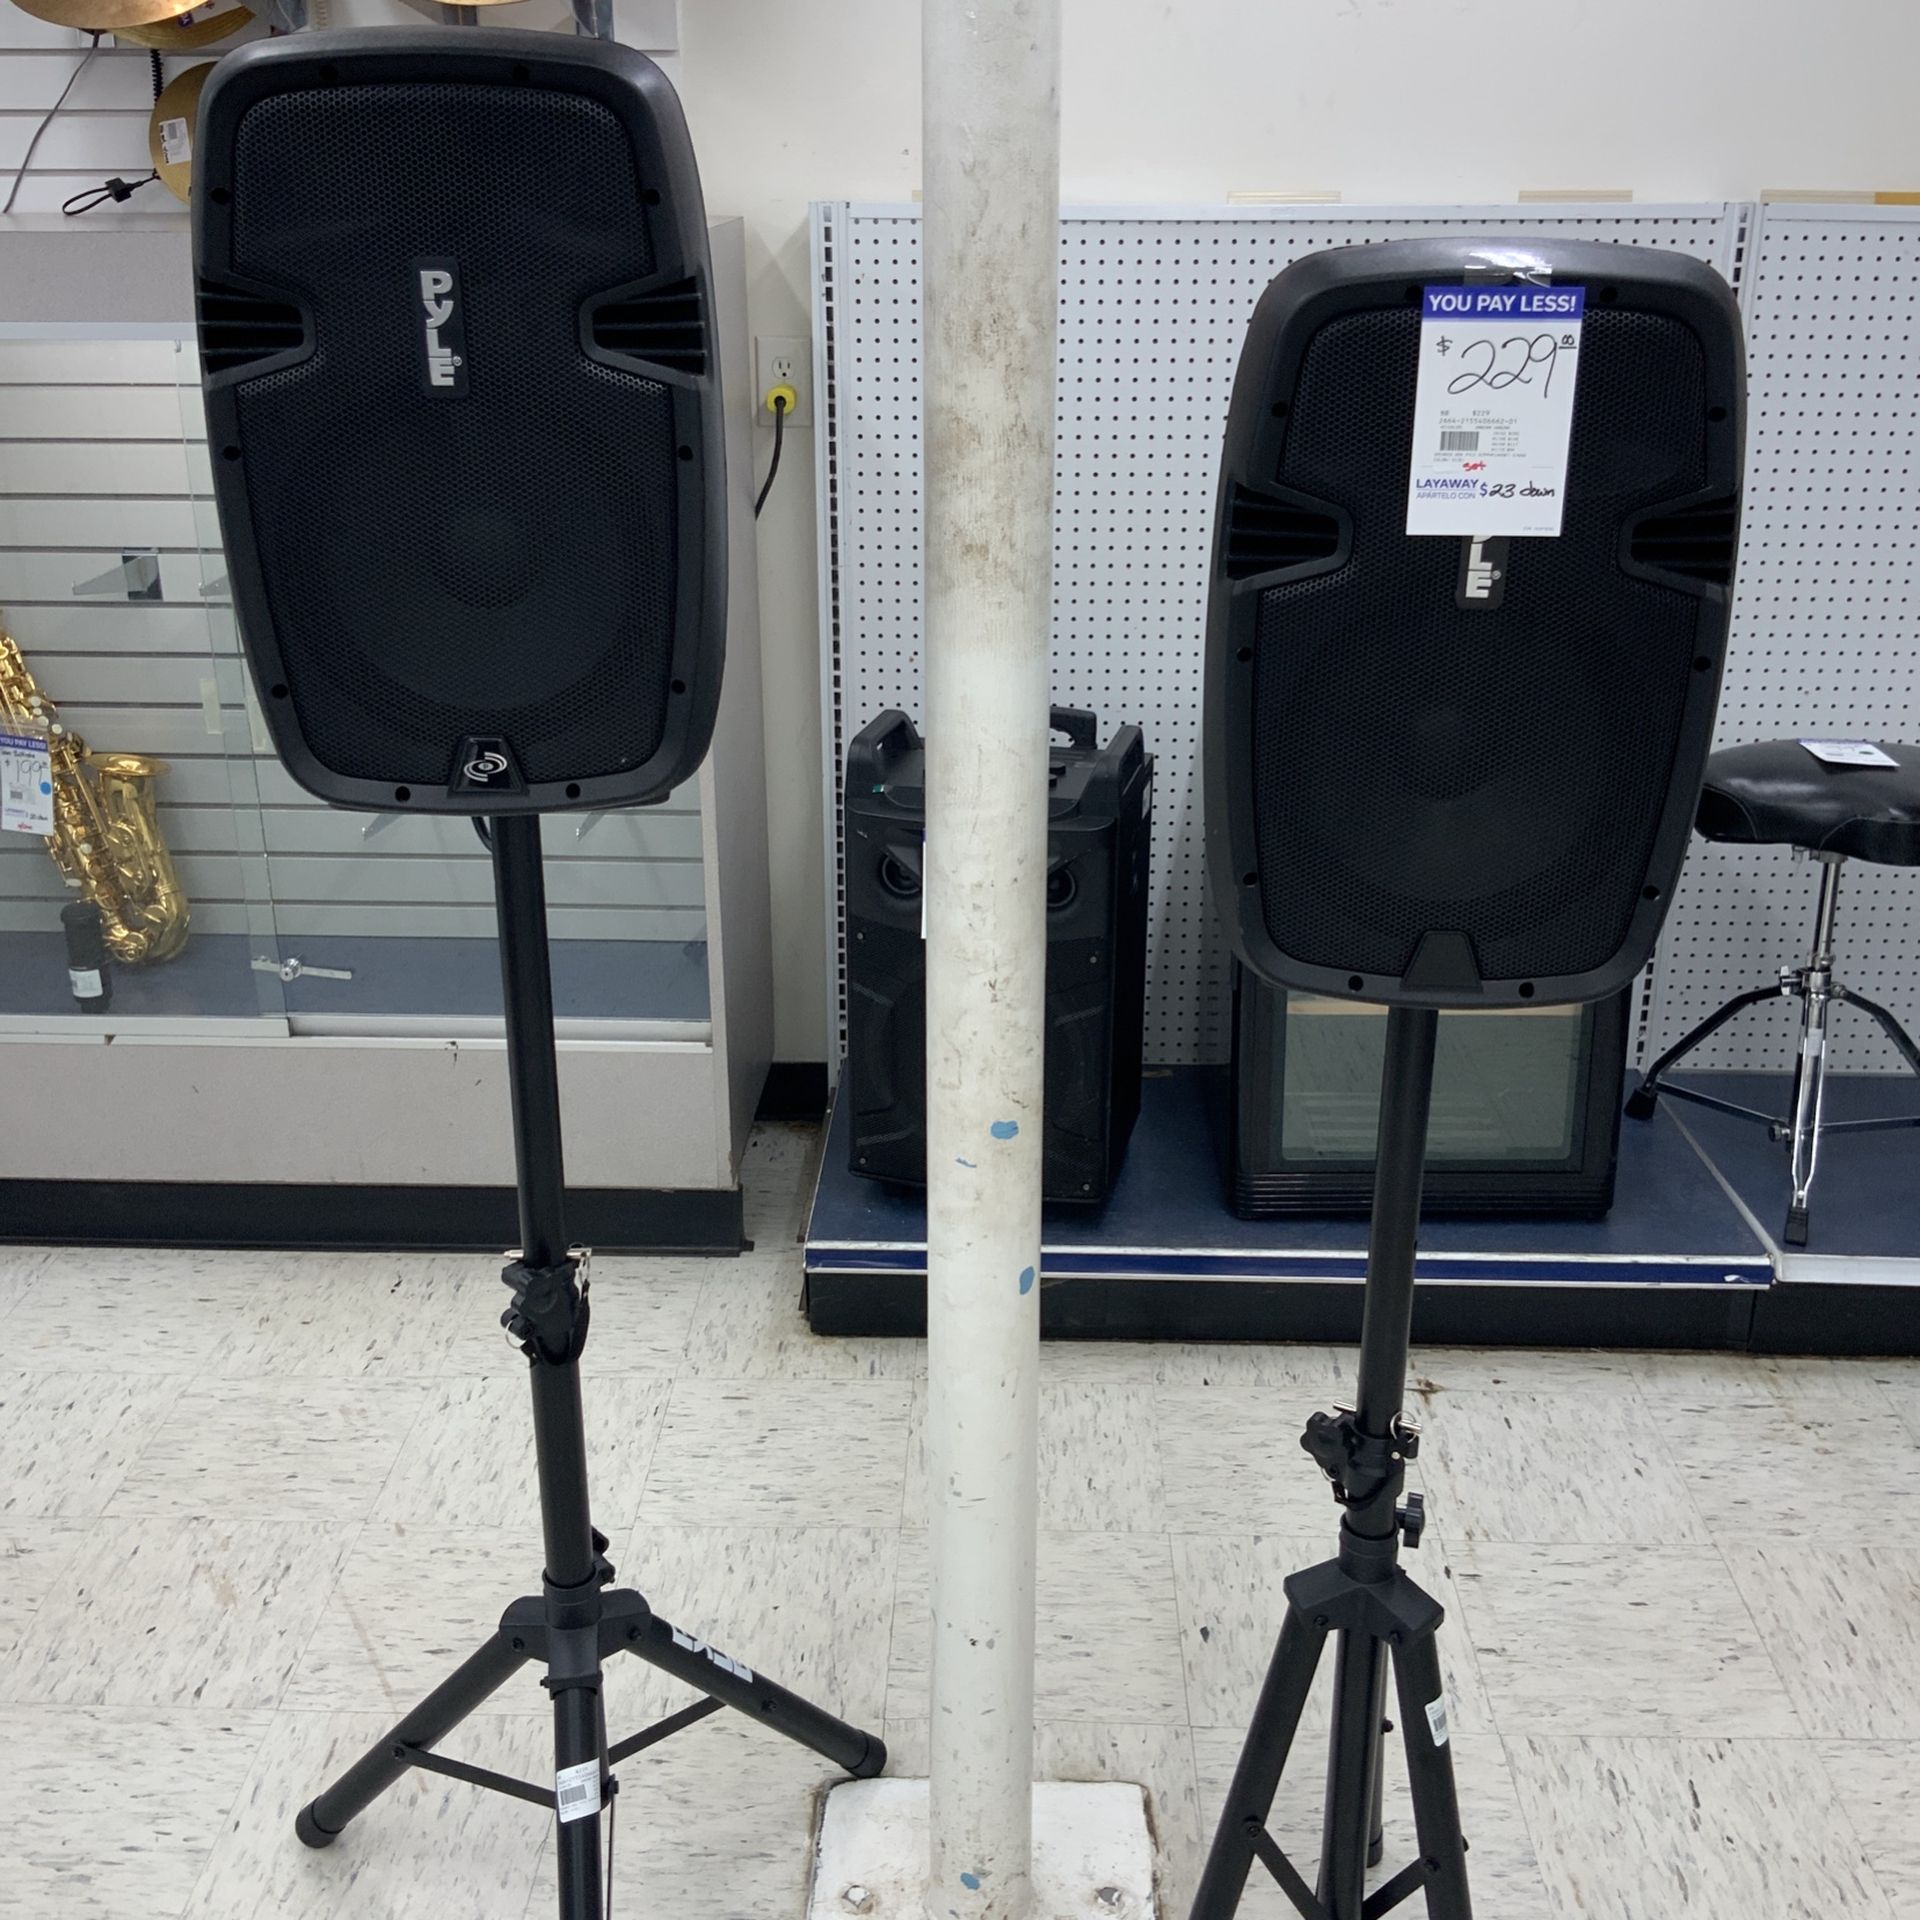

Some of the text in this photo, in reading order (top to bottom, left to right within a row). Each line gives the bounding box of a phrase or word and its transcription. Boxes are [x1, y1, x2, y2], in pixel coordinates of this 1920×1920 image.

[1429, 294, 1577, 312] YOU PAY LESS!
[1447, 334, 1557, 398] 229
[1416, 479, 1479, 489] LAYAWAY
[1520, 480, 1555, 498] down
[1458, 492, 1476, 500] CON
[14, 738, 28, 748] PAY
